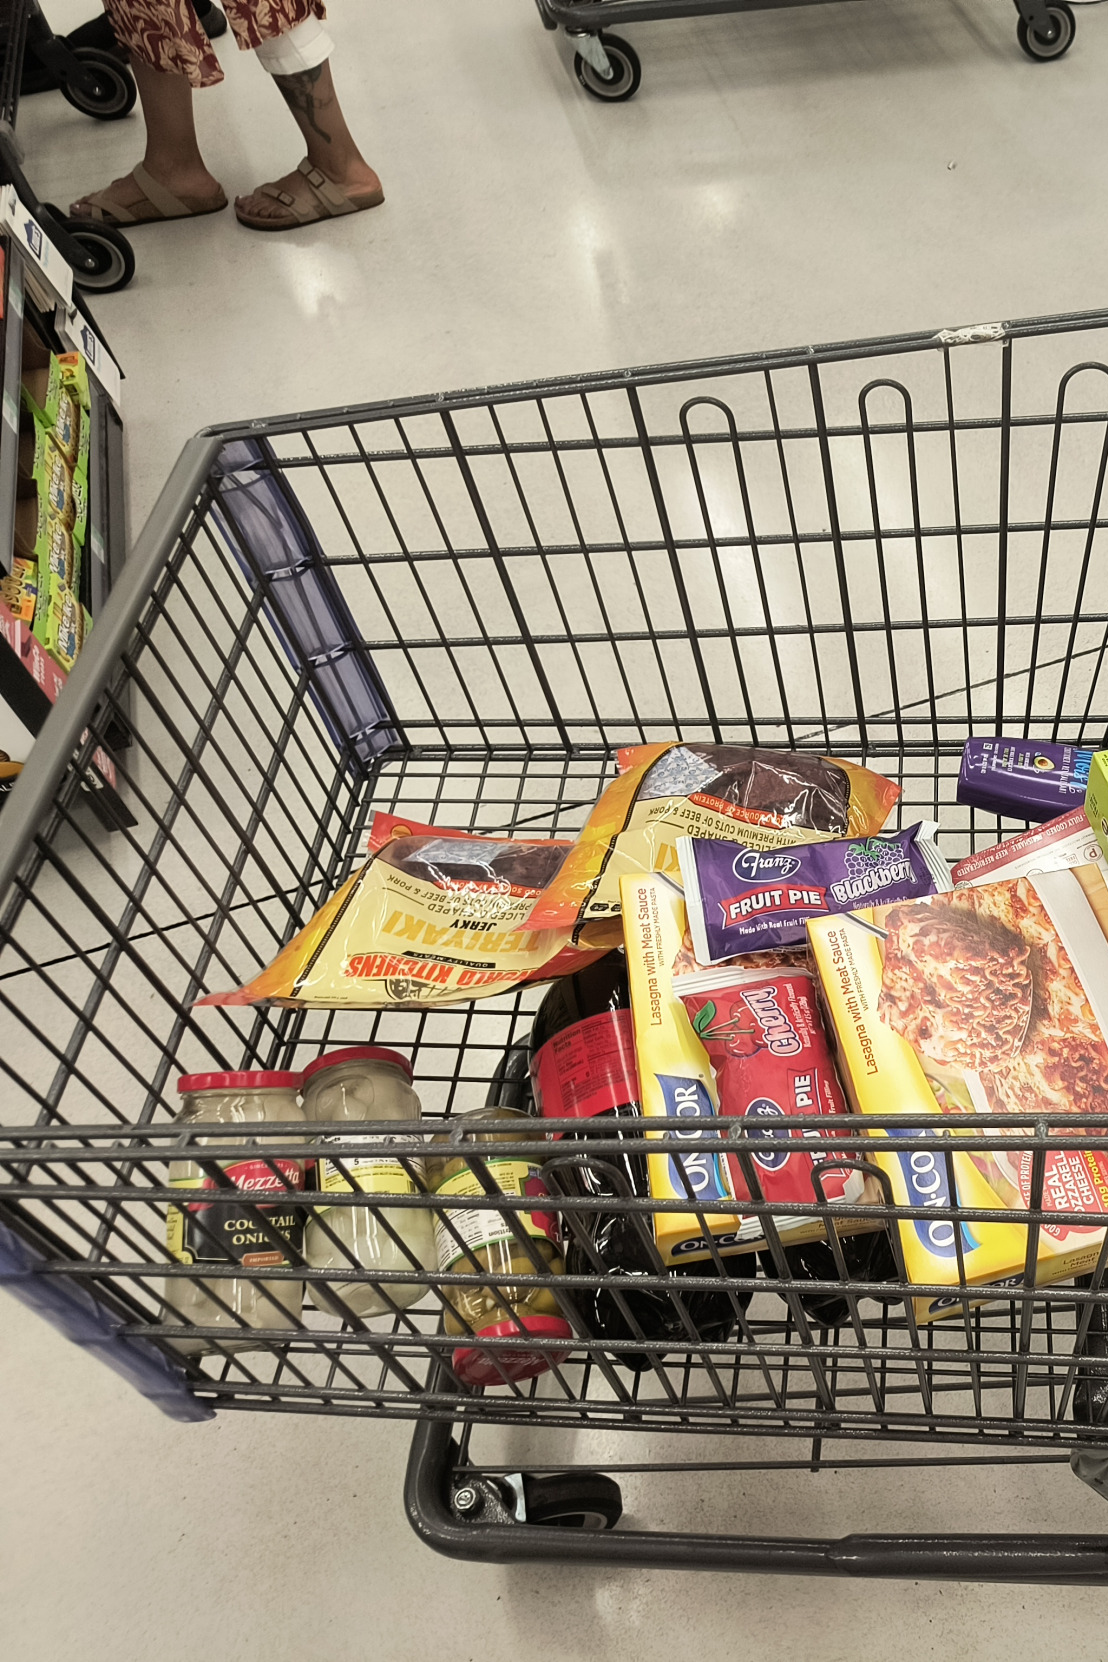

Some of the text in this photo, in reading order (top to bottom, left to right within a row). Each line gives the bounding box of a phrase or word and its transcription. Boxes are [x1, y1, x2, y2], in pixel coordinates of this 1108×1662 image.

[693, 794, 723, 809] PROTEIN
[676, 808, 774, 843] PREMIUM CUTS OF BEEF
[741, 853, 797, 878] Franz
[386, 874, 445, 902] BEEF PORK
[730, 884, 823, 920] FRUIT PIE
[379, 909, 541, 952] TERIYAKI
[448, 918, 497, 931] JERKY
[651, 906, 659, 925] MADE
[739, 925, 756, 936] Made
[768, 919, 784, 932] Real
[784, 917, 799, 930] Fruit
[653, 924, 663, 950] FRESHLY
[343, 954, 452, 984] KITCHENS
[638, 888, 663, 1026] Lasagna with Meat Sauce
[657, 950, 665, 967] WITH
[839, 927, 869, 1012] WITH FRESHLY MADE PASTA
[742, 986, 801, 1055] Cherry
[827, 931, 878, 1076] Lasagna with Meat Sauce
[794, 1074, 814, 1108] PIE
[1045, 1164, 1067, 1210] REAL
[1068, 1155, 1095, 1206] CHEESE
